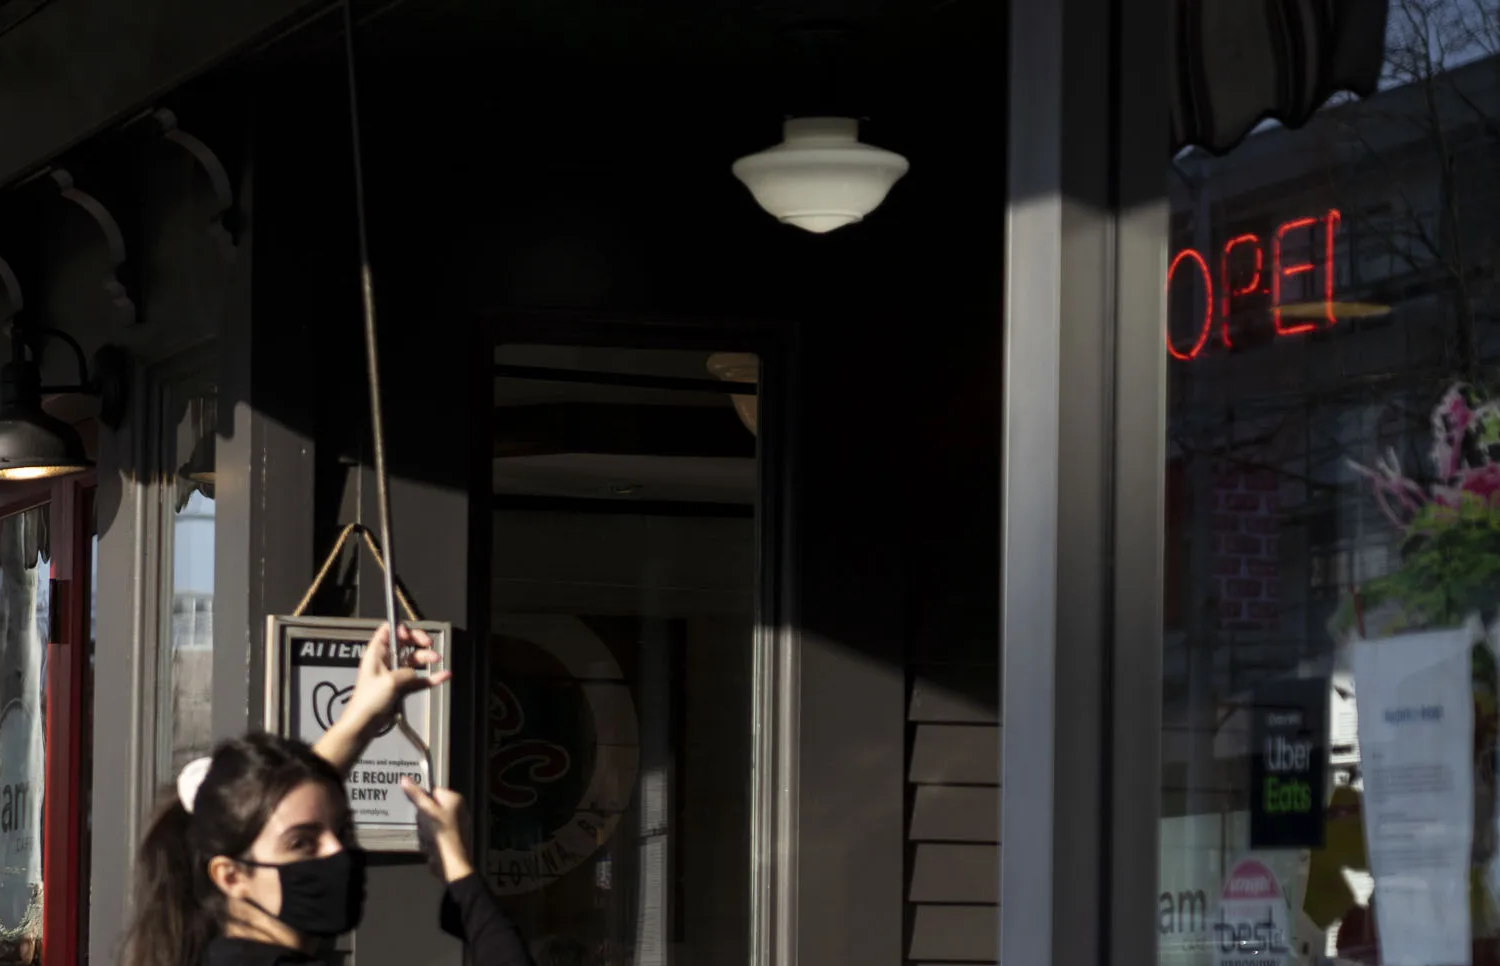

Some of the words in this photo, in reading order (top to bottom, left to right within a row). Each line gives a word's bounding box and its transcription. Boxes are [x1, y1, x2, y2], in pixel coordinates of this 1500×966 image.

[1266, 735, 1312, 772] Uber
[351, 788, 388, 801] ENTRY
[1264, 776, 1312, 813] Eats
[1213, 906, 1288, 953] best
